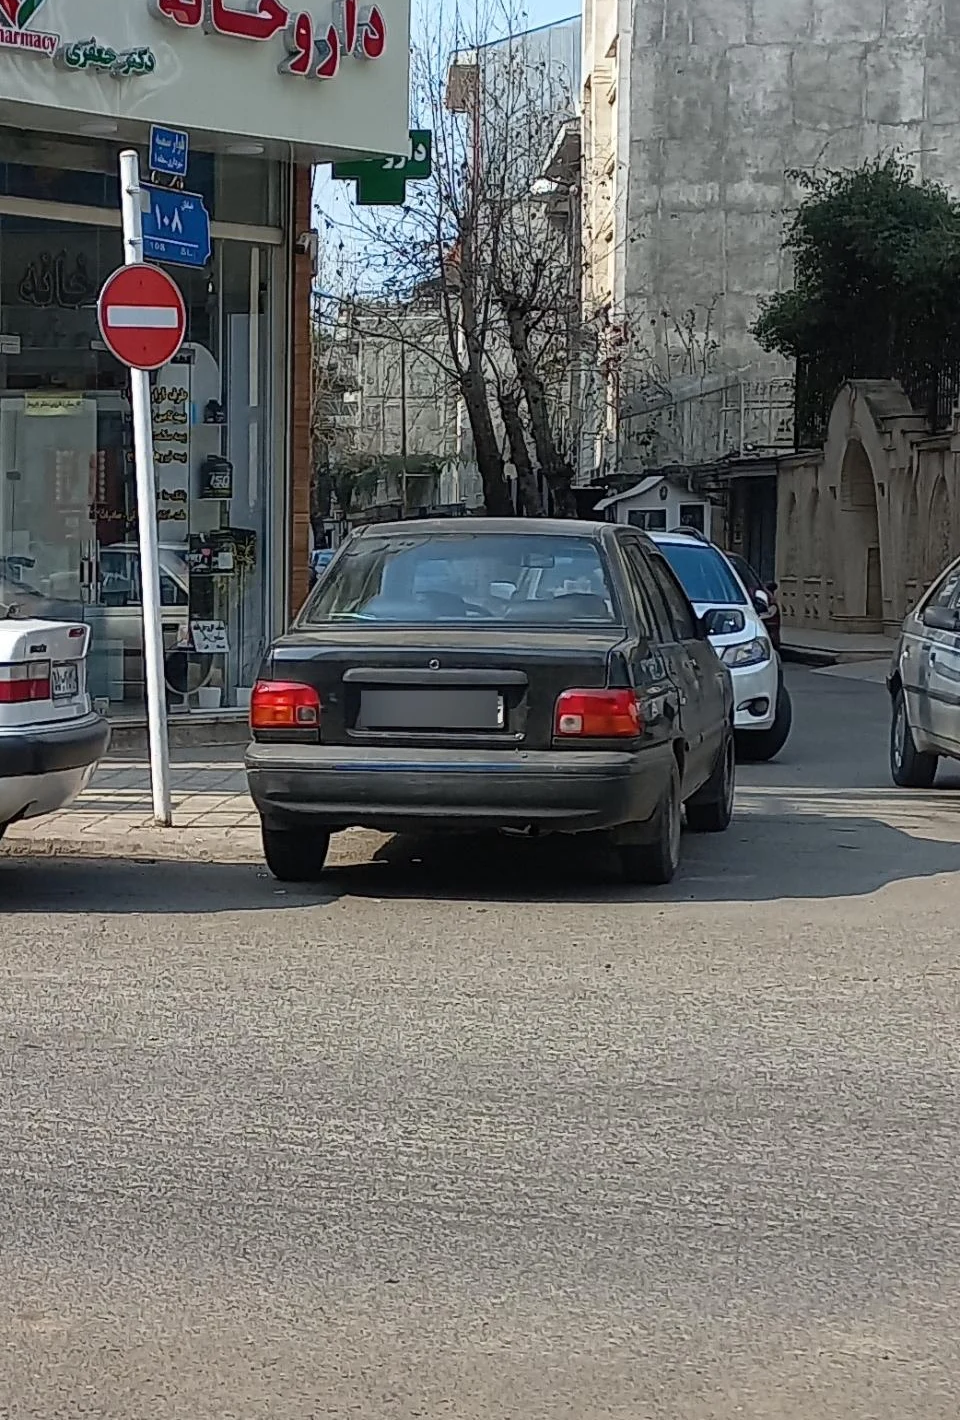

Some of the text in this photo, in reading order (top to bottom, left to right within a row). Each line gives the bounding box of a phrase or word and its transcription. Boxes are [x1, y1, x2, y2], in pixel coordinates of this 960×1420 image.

[65, 37, 156, 74] دکتر جعفری
[155, 204, 182, 234] ۱۰۸
